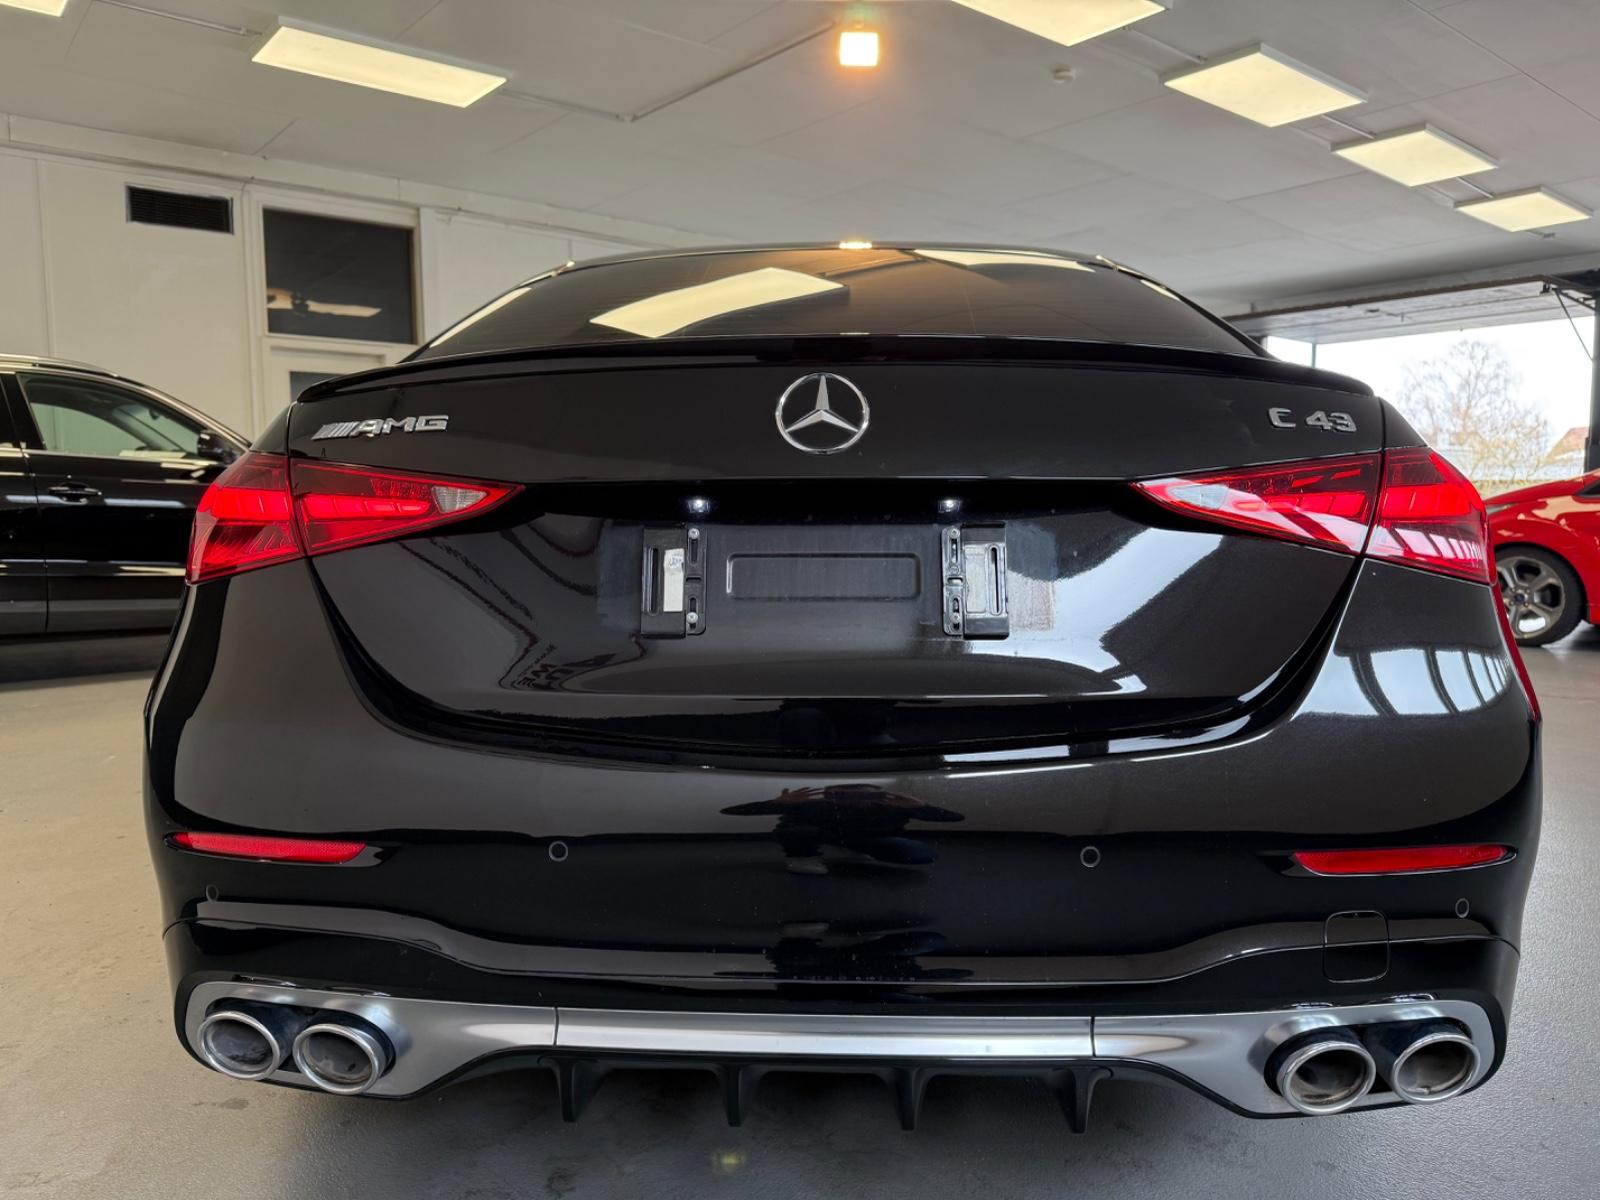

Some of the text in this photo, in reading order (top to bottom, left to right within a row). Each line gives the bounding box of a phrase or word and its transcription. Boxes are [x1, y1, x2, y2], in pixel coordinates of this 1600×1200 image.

[350, 415, 449, 437] AMG
[1268, 407, 1357, 432] C 43
